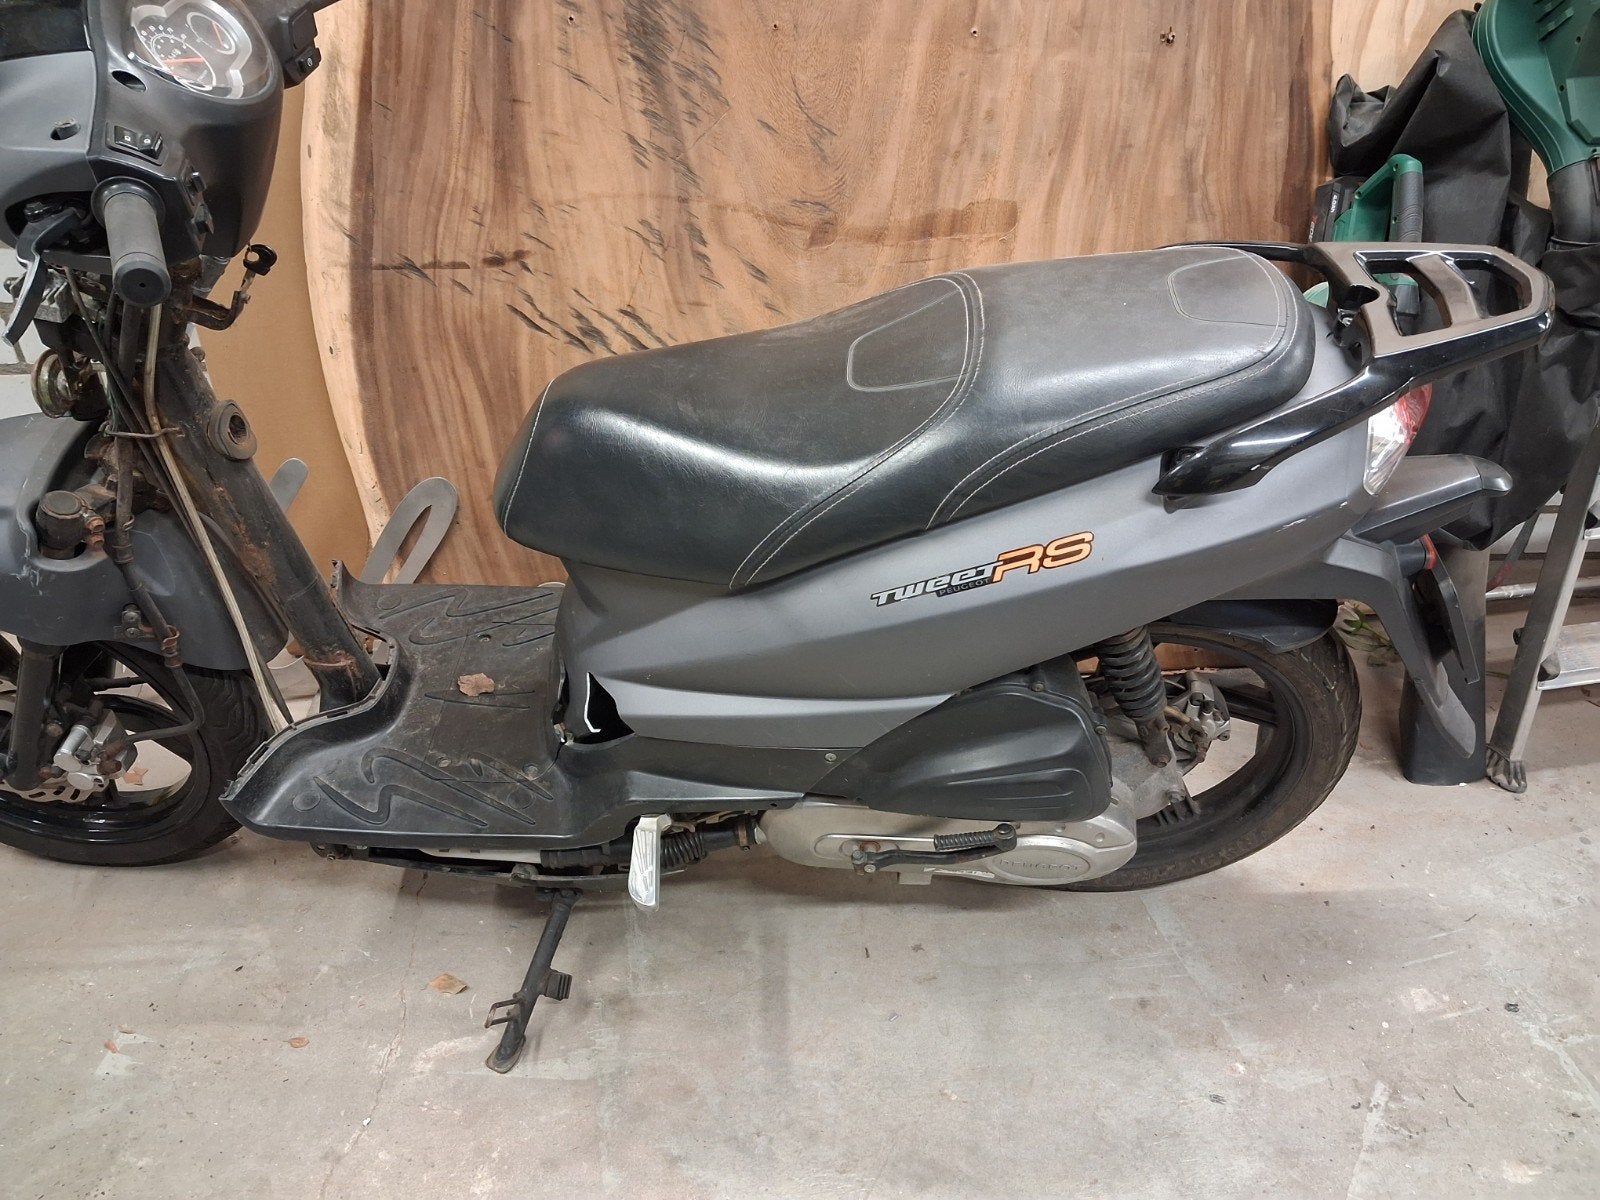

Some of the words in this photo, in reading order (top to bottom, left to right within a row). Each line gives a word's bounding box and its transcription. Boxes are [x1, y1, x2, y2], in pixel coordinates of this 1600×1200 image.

[993, 531, 1094, 582] RS
[939, 578, 990, 597] PEUGEOT
[999, 859, 1082, 871] PEUGEOT
